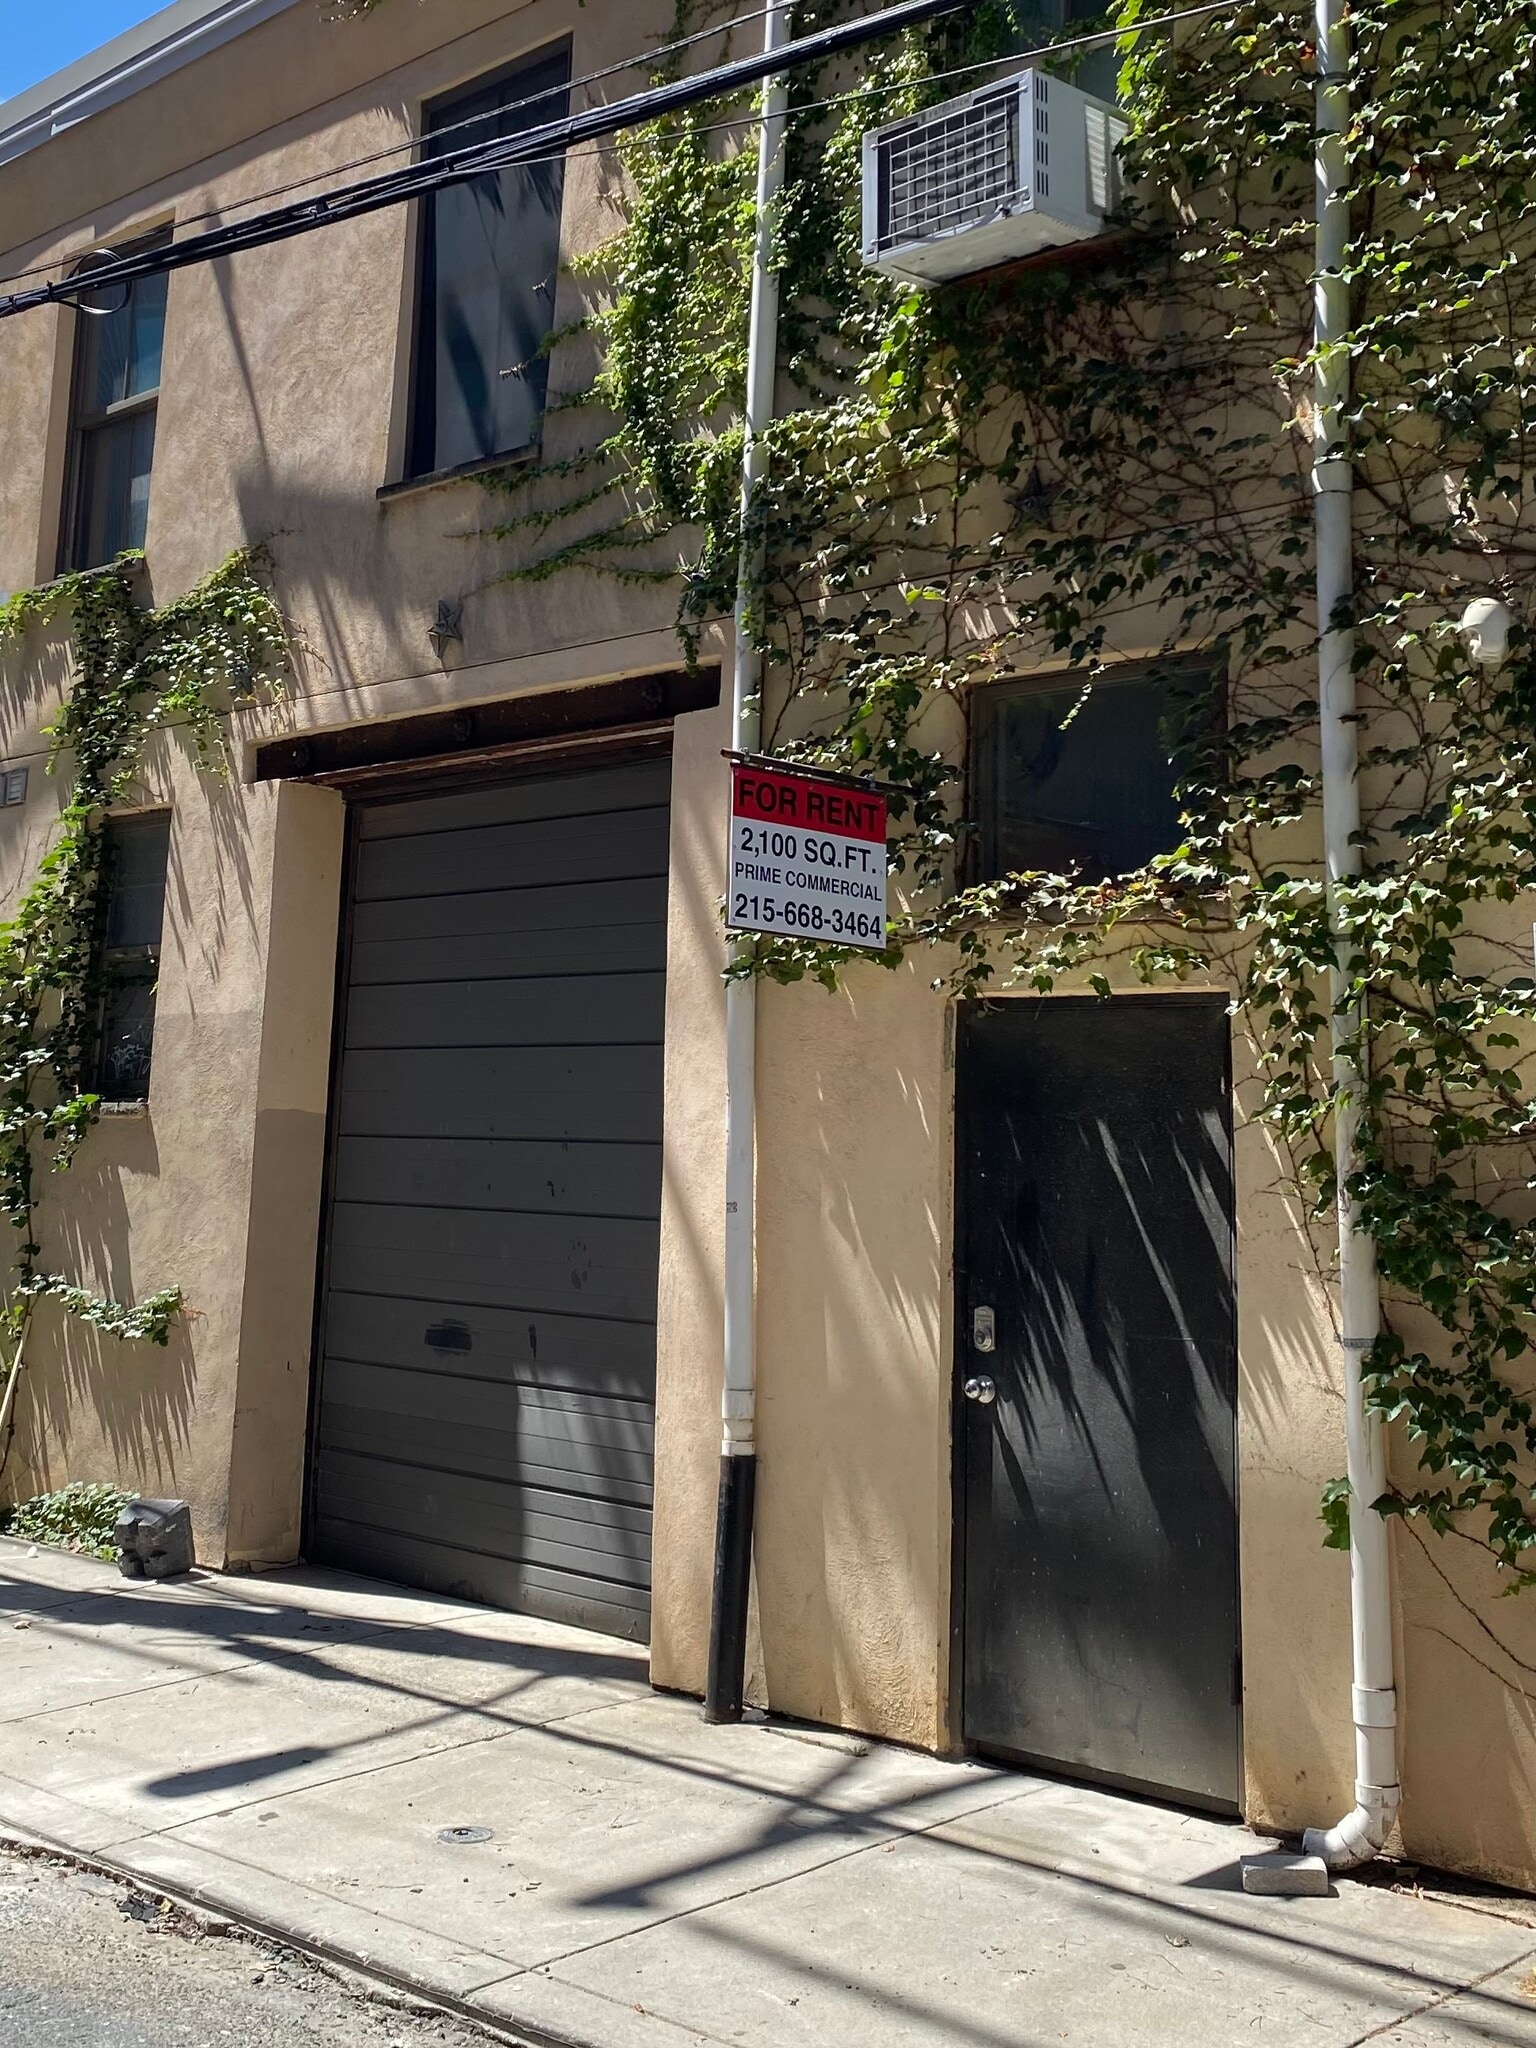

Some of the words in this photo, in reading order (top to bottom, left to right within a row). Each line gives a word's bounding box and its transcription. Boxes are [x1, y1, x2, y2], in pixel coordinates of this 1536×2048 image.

[738, 778, 797, 817] FOR
[806, 791, 881, 833] RENT
[740, 827, 797, 859] 2,100
[804, 838, 877, 874] SQ.FT.
[735, 862, 782, 885] PRIME
[785, 870, 882, 902] COMMERCIAL
[734, 893, 882, 940] 215-668-3464
